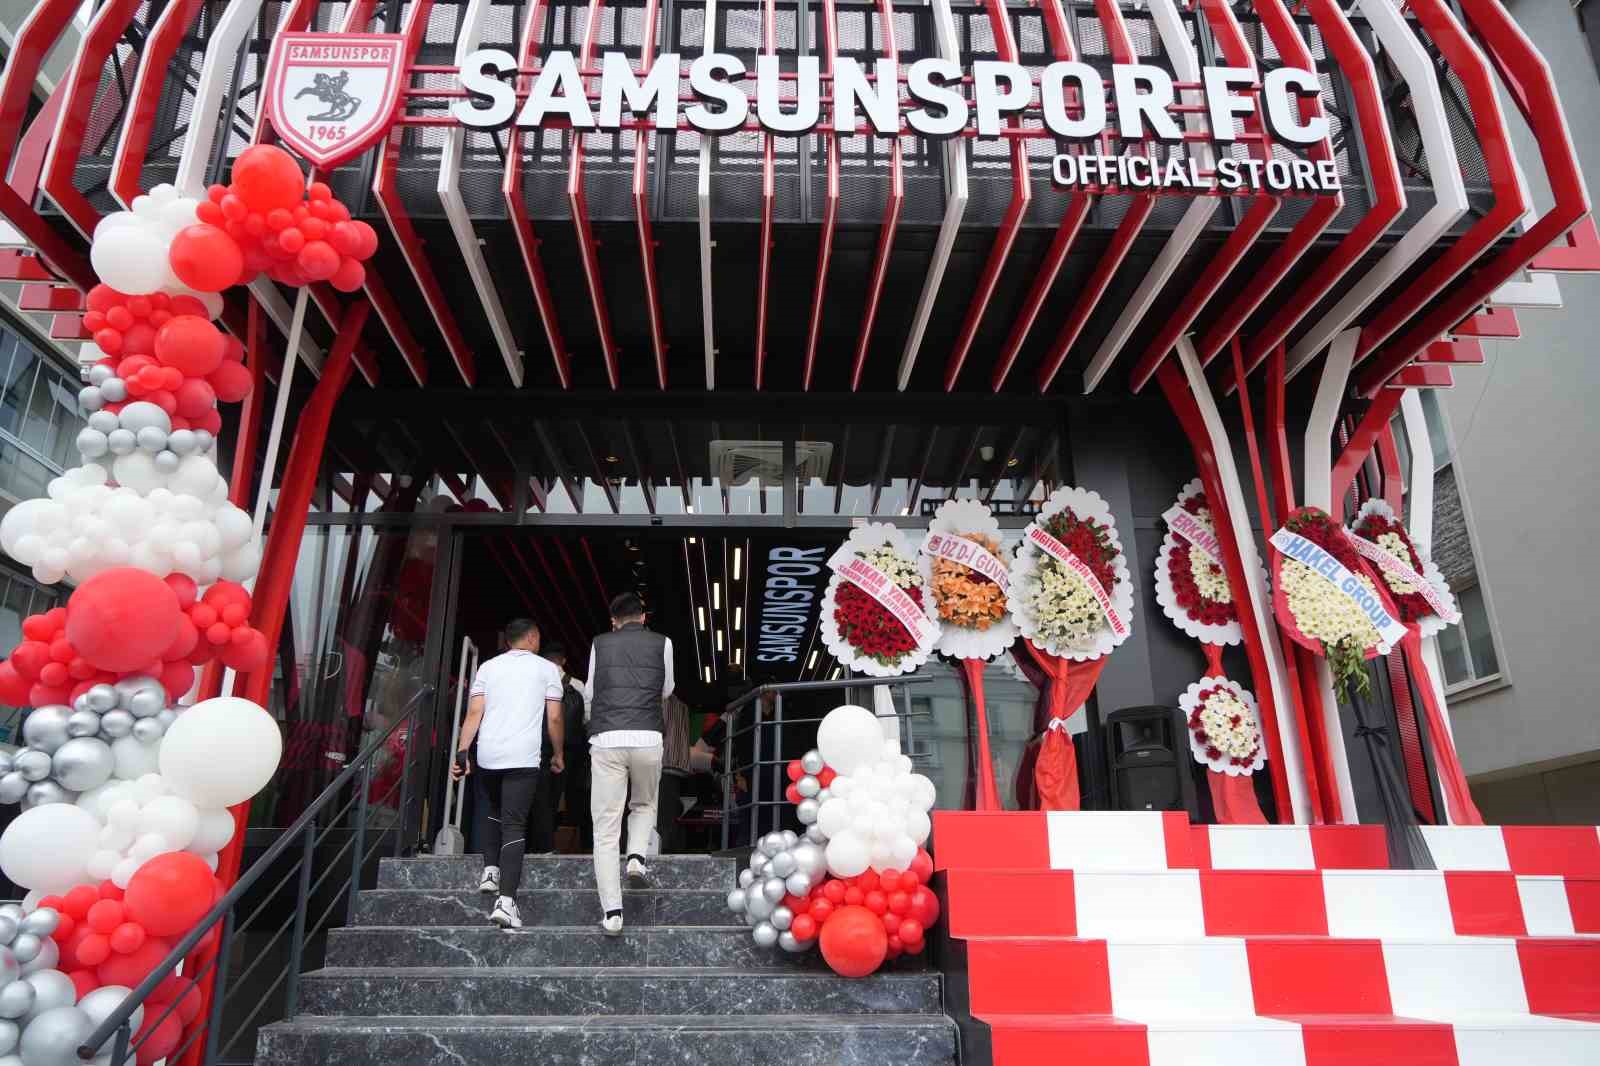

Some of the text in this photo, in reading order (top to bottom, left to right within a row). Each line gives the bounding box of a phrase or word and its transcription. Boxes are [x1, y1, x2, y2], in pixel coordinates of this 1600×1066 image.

[291, 46, 390, 60] SAMSUNSPOR
[457, 49, 1331, 145] SAMSUNSPOR FC
[309, 125, 346, 141] 1965
[1053, 154, 1341, 190] OFFICIAL STORE
[1283, 538, 1341, 581] HAKEL
[1341, 577, 1392, 629] GROUP
[757, 546, 826, 662] SAMSUNSPOR
[889, 585, 922, 623] YAVUZ
